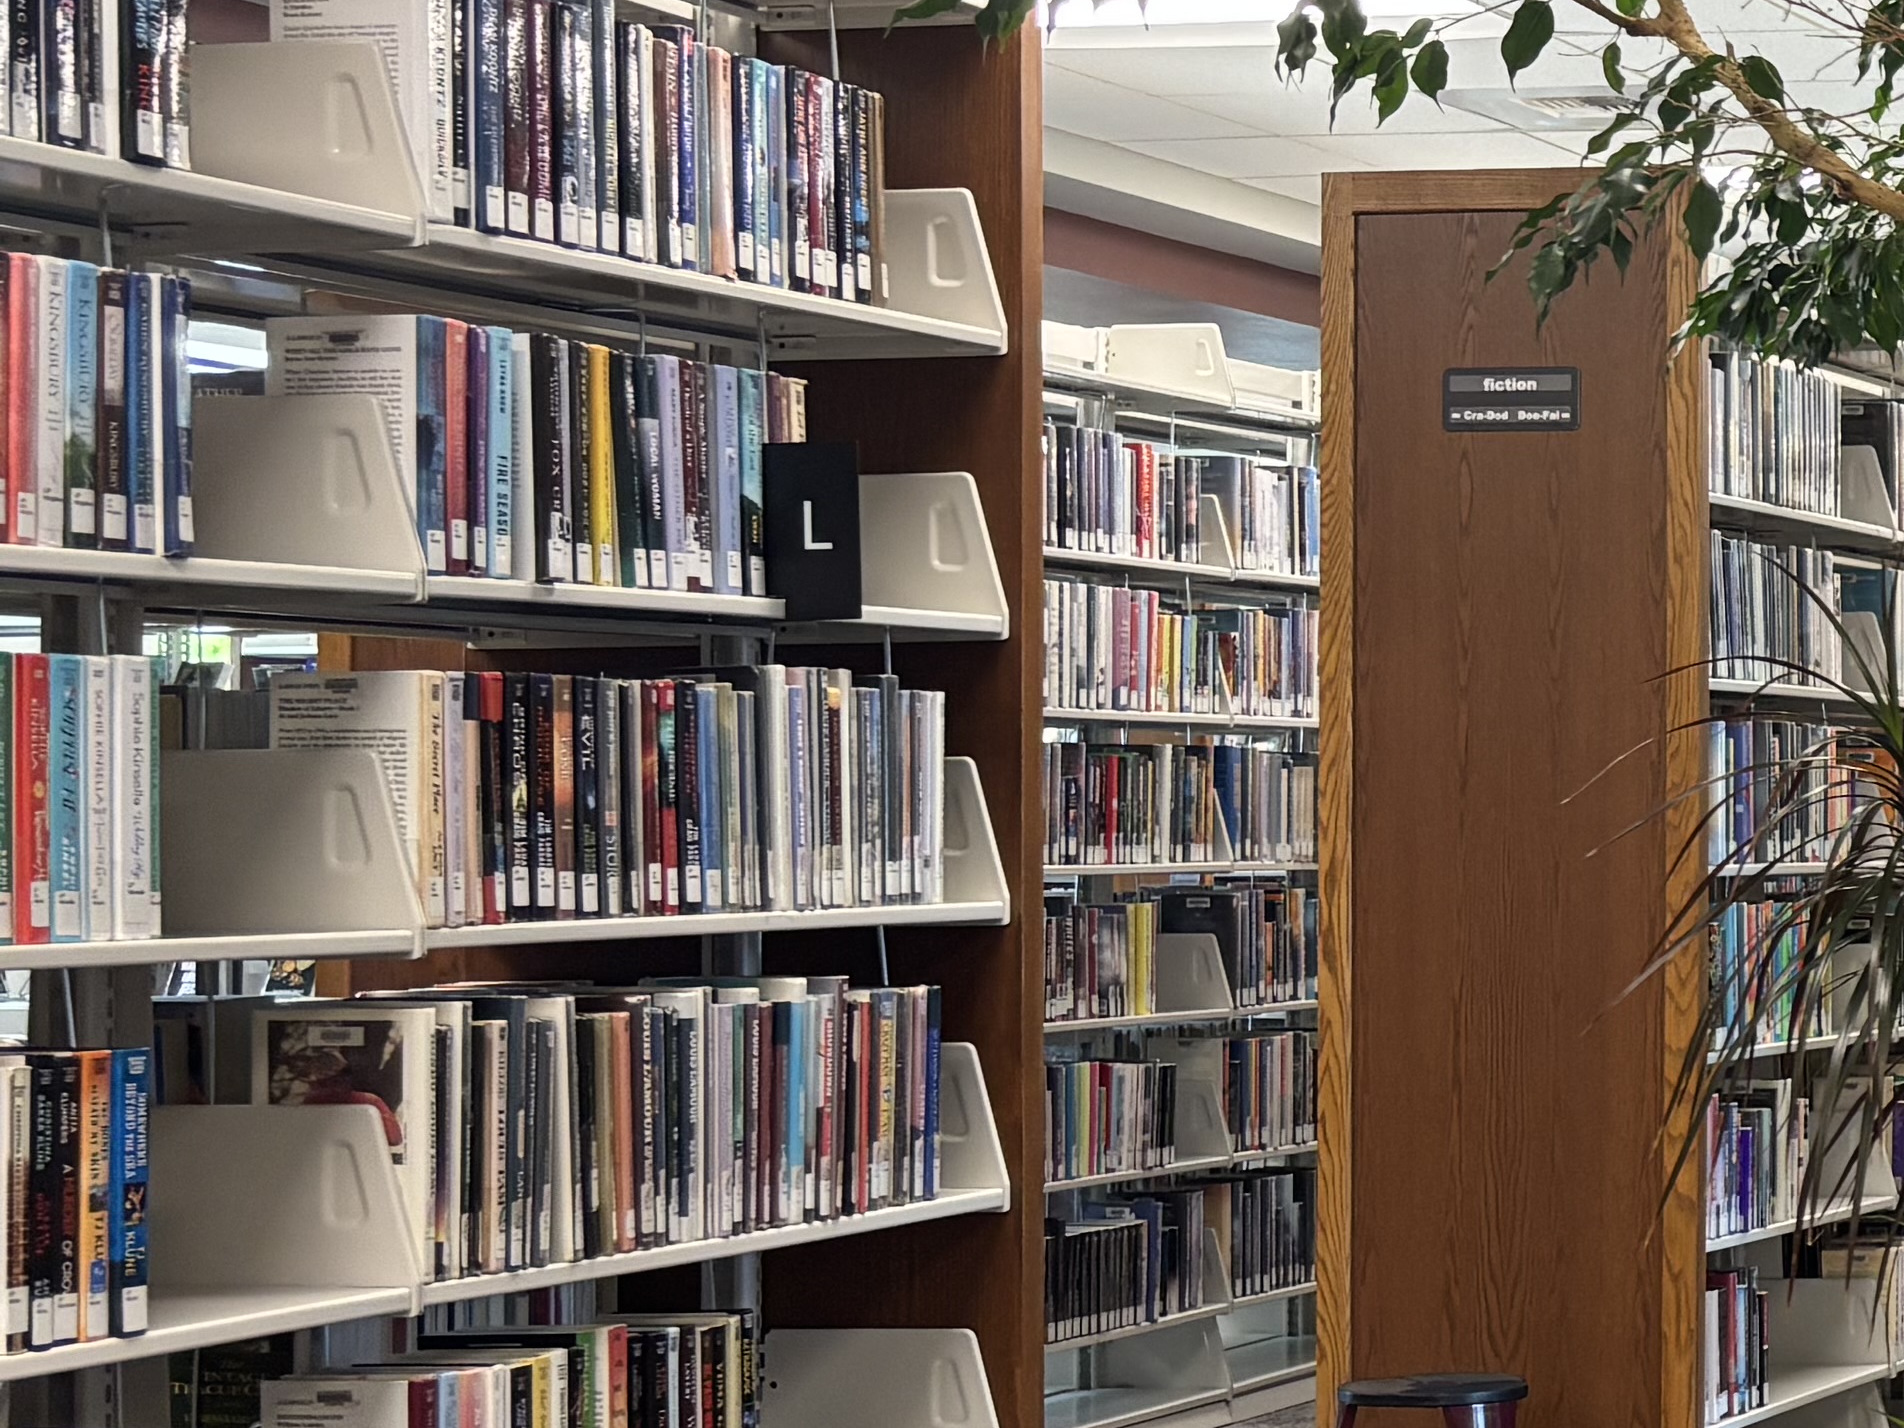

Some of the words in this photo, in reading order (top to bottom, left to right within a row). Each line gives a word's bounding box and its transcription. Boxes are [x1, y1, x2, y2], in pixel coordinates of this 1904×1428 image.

[436, 47, 446, 109] KOONTZ
[48, 291, 60, 398] KINGSBURY
[79, 299, 92, 404] KINGSBURY
[1483, 377, 1537, 392] fiction
[109, 421, 120, 490] KINGSBURY
[496, 455, 509, 486] FIRE
[551, 439, 561, 476] FOX
[650, 432, 662, 467] LOCAL
[650, 473, 663, 521] WOMAN
[803, 500, 834, 550] L
[94, 689, 105, 736] SOPHIE
[131, 692, 146, 744] Sophie
[430, 713, 442, 737] The
[94, 740, 105, 805] KINSELLA
[132, 748, 146, 807] Kinsella
[430, 740, 442, 779] Secret
[430, 781, 442, 815] Place
[125, 1082, 138, 1130] BEYOND
[137, 1092, 147, 1167] SOMEWHERE
[125, 1132, 137, 1152] THE
[125, 1154, 138, 1180] SEA
[62, 1239, 74, 1258] OF
[124, 1229, 137, 1277] KLUNE
